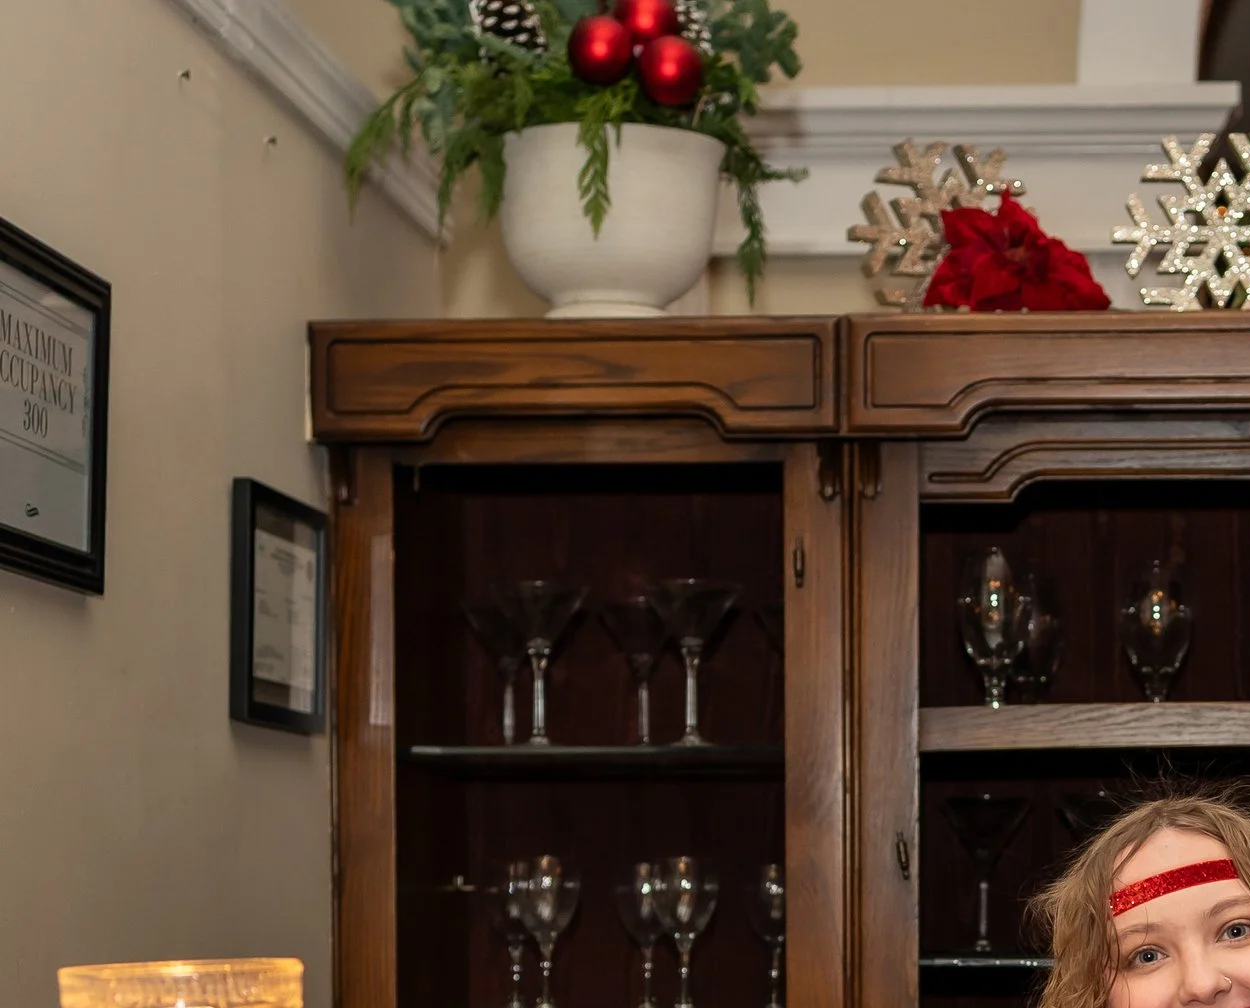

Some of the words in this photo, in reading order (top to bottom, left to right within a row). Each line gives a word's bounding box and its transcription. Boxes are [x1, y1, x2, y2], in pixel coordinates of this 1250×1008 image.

[0, 309, 73, 377] MAXIMUM
[0, 350, 77, 415] CCUPANCY
[23, 398, 48, 438] 300
